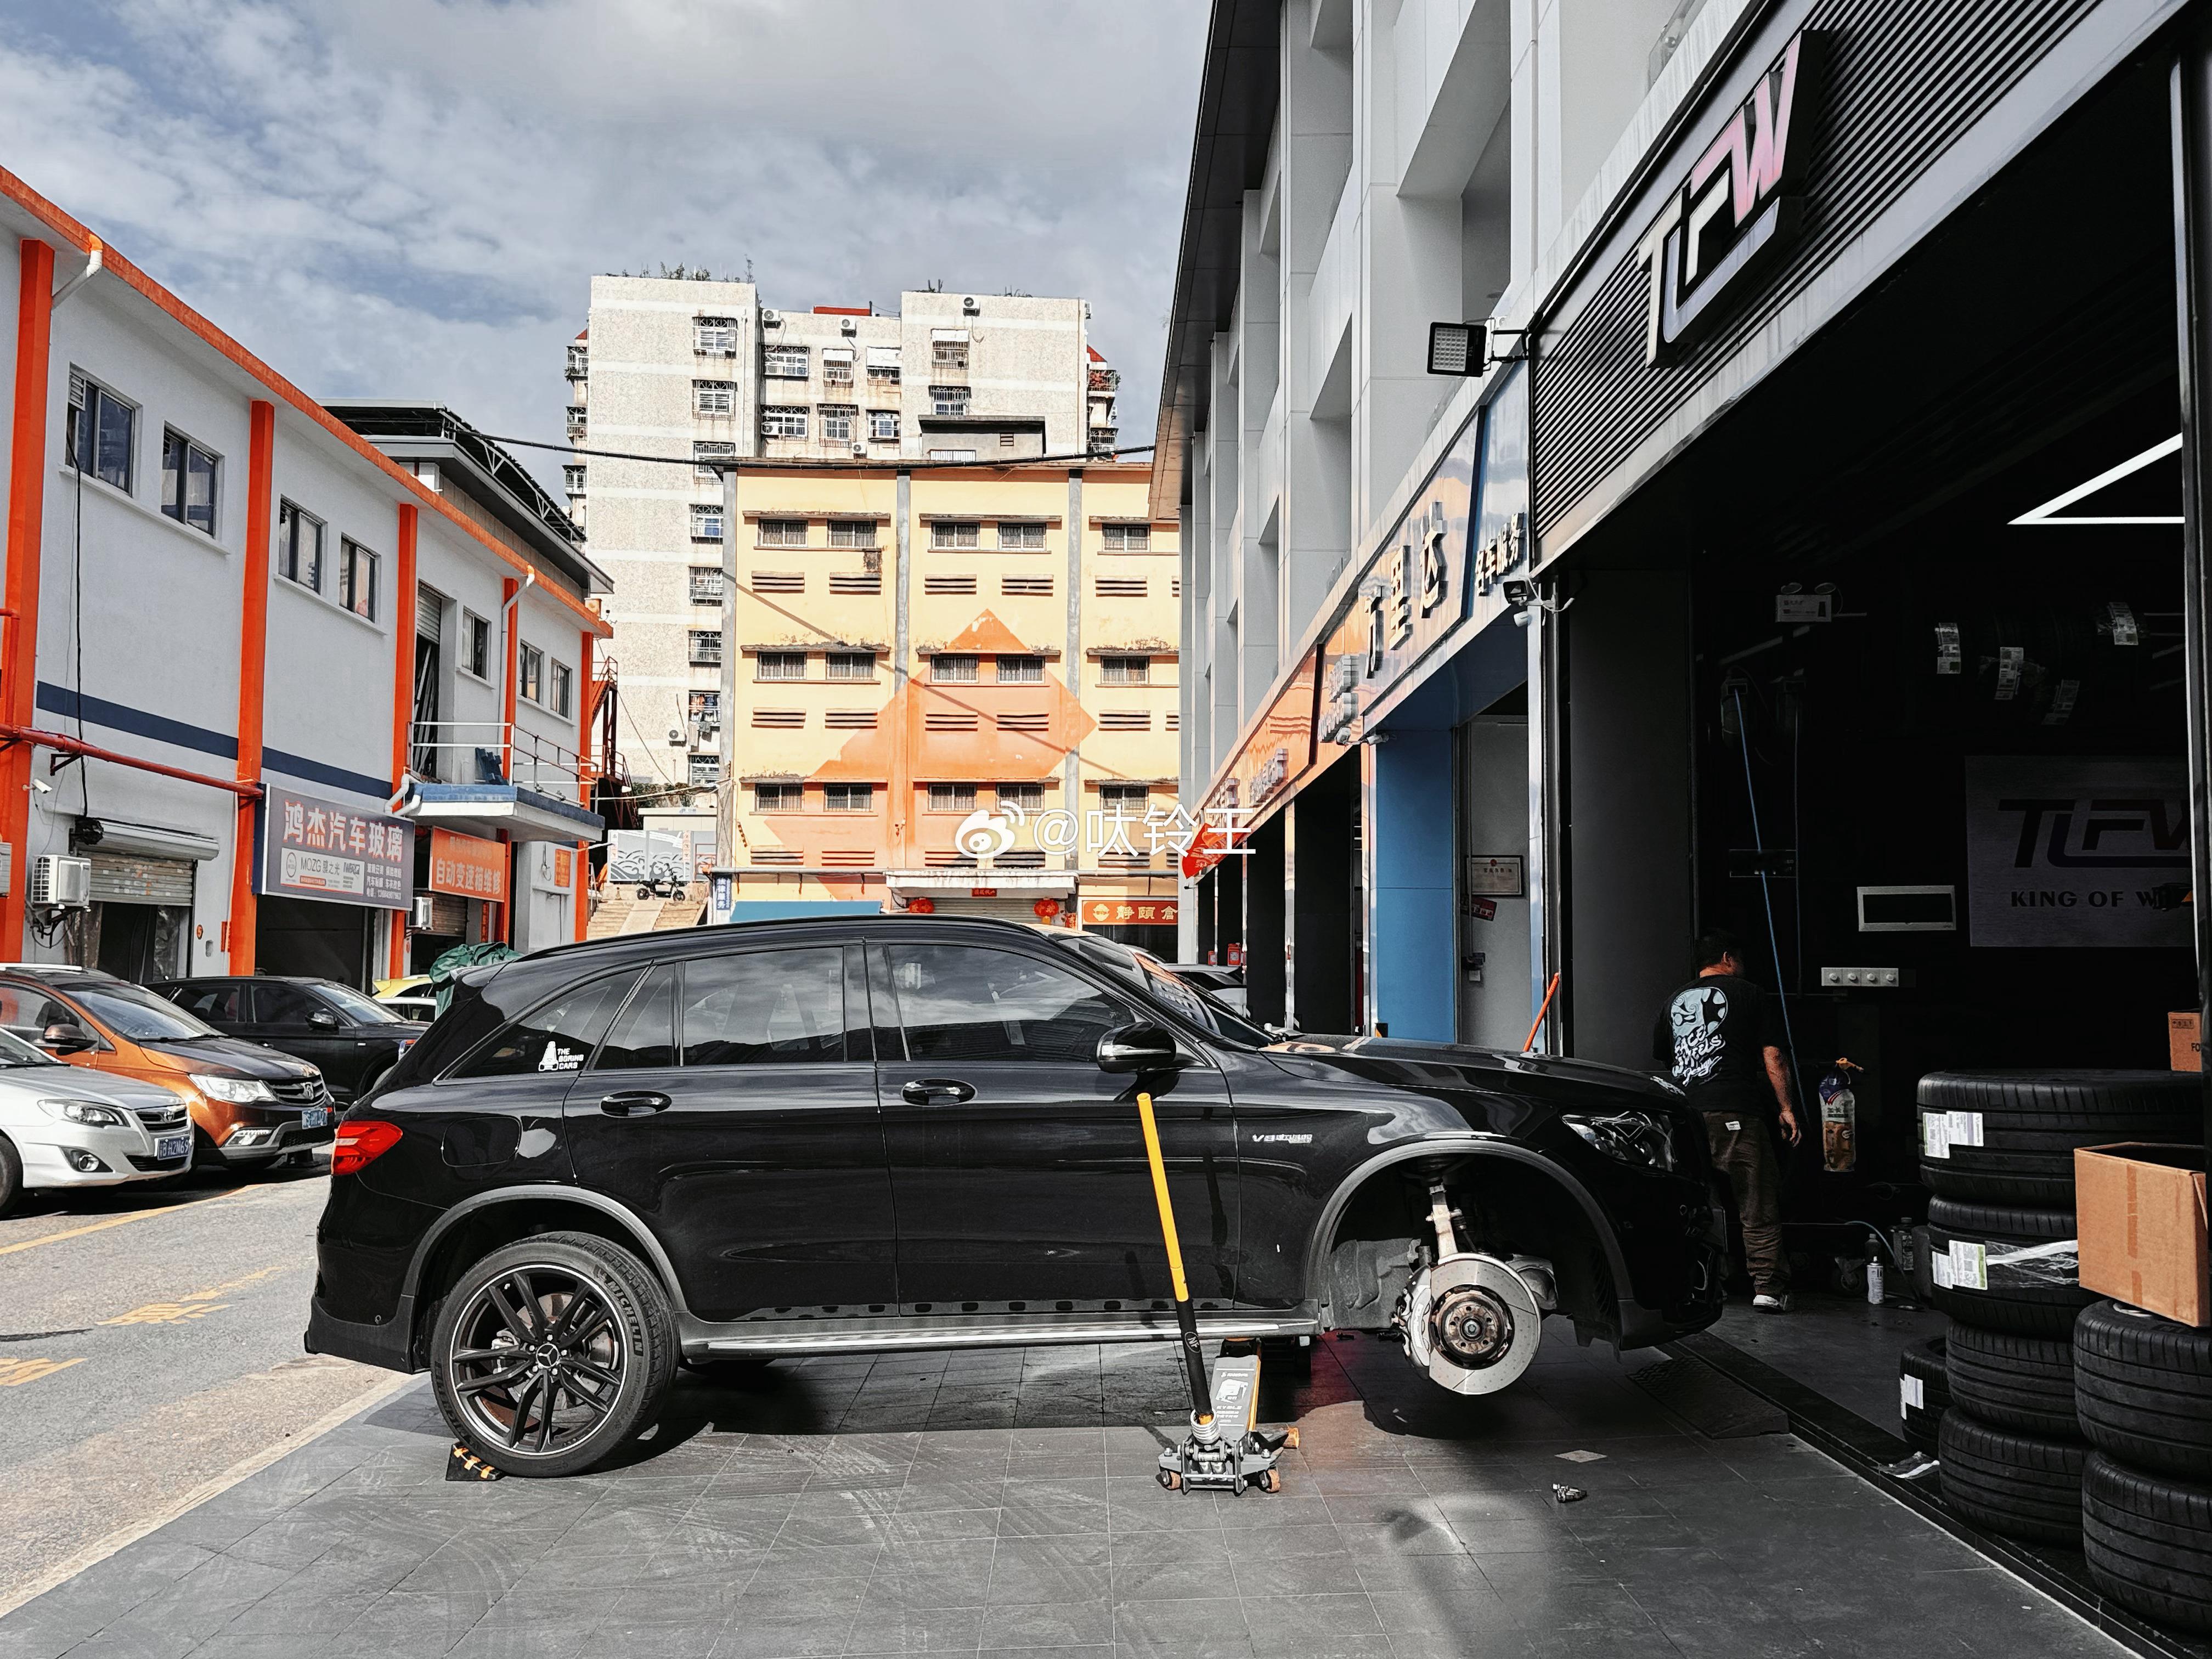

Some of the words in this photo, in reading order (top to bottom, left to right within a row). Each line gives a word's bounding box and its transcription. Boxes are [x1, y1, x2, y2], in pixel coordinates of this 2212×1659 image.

[284, 799, 403, 862] 鸿杰汽车玻璃
[301, 857, 321, 872] MOZG
[436, 857, 501, 894] 自动变速箱维修
[2011, 891, 2077, 907] KING
[2088, 891, 2124, 907] OF
[558, 1054, 584, 1063] BORING
[606, 1279, 643, 1356] MICHELIN
